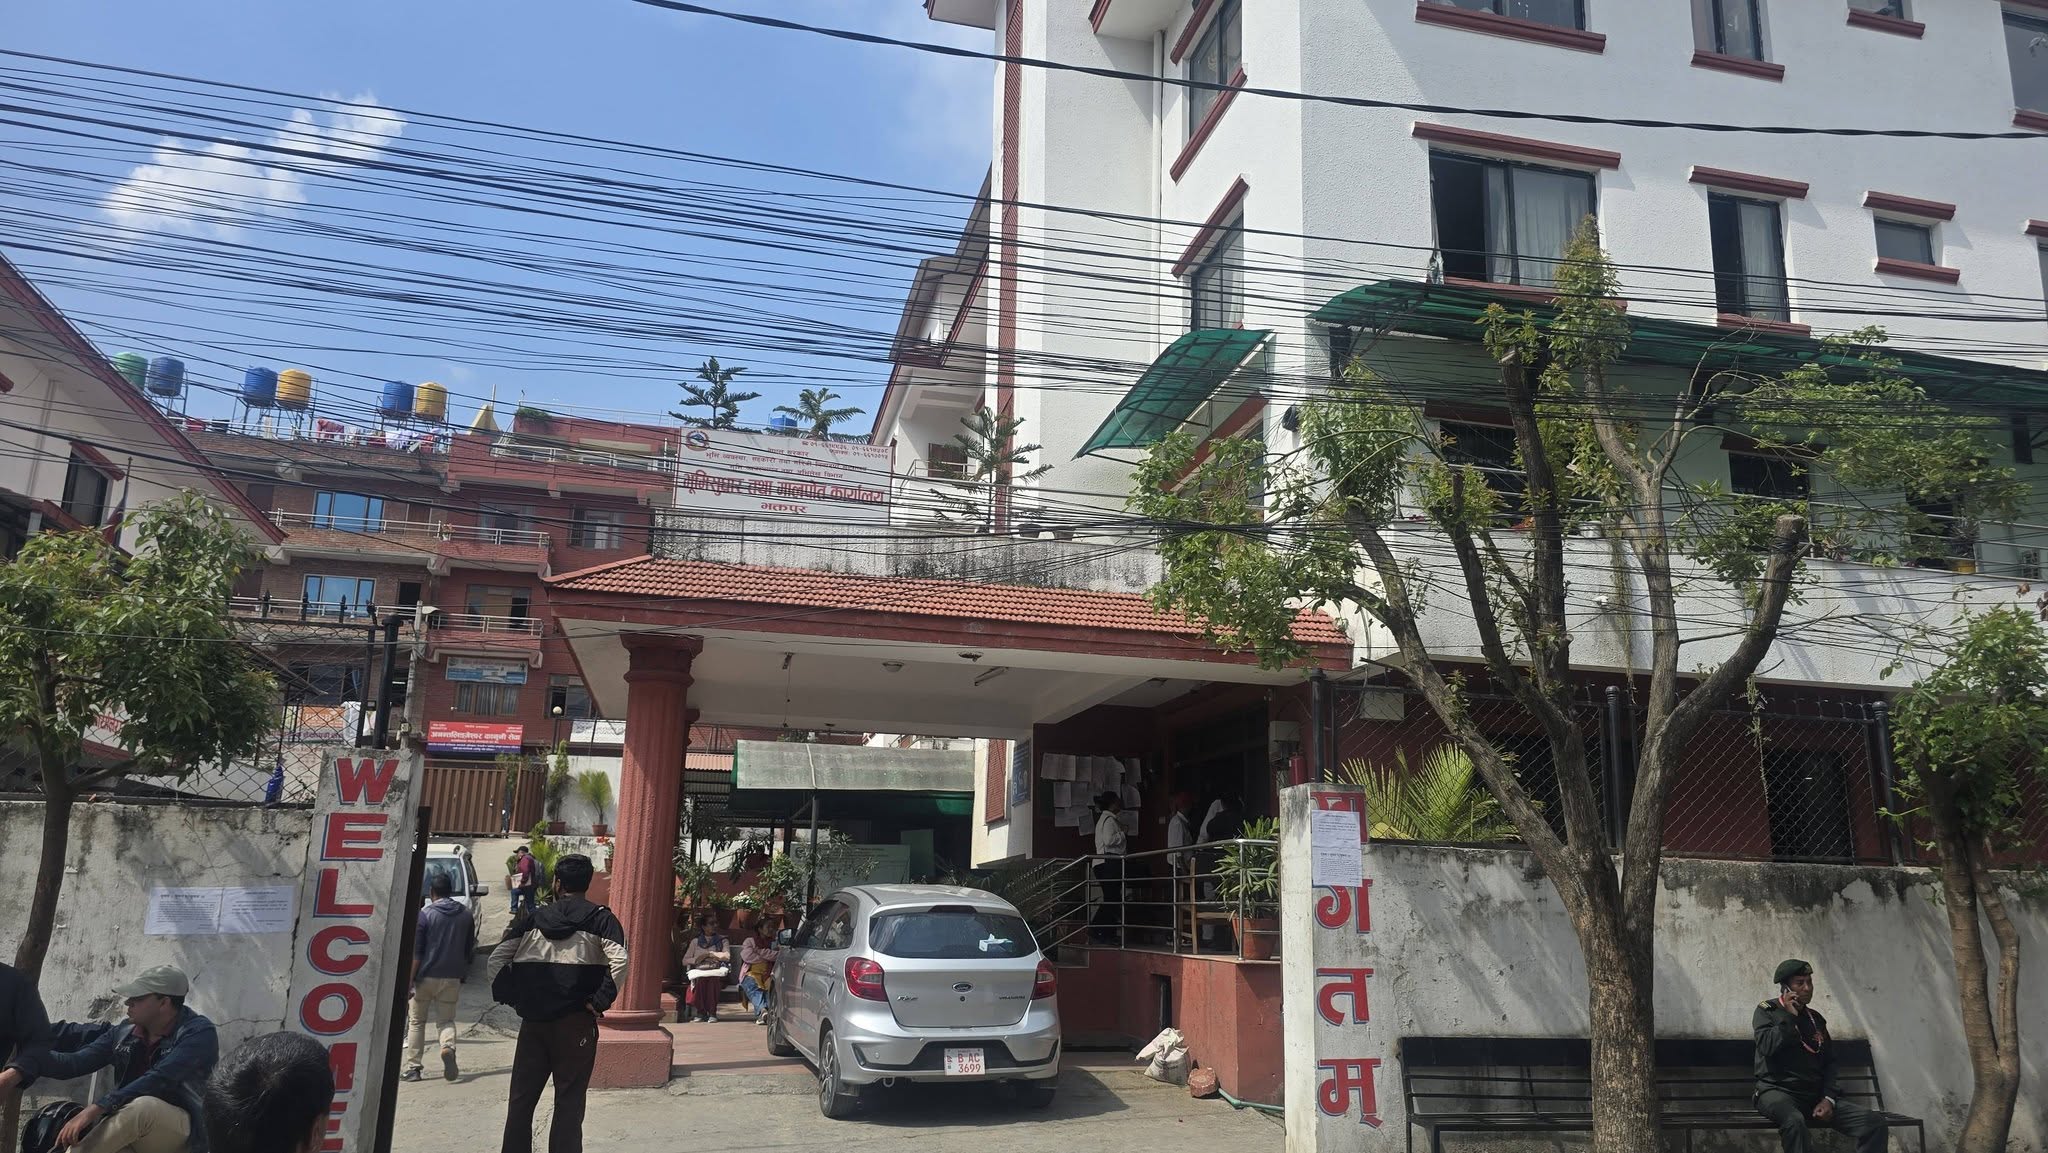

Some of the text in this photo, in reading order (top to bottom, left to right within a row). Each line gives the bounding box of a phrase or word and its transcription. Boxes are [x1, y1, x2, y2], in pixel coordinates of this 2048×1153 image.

[748, 479, 774, 496] तथा
[777, 480, 827, 500] मालपोत
[830, 485, 885, 505] कार्यालय
[957, 1053, 964, 1063] B
[968, 1053, 980, 1063] AC
[958, 1063, 982, 1073] 3699
